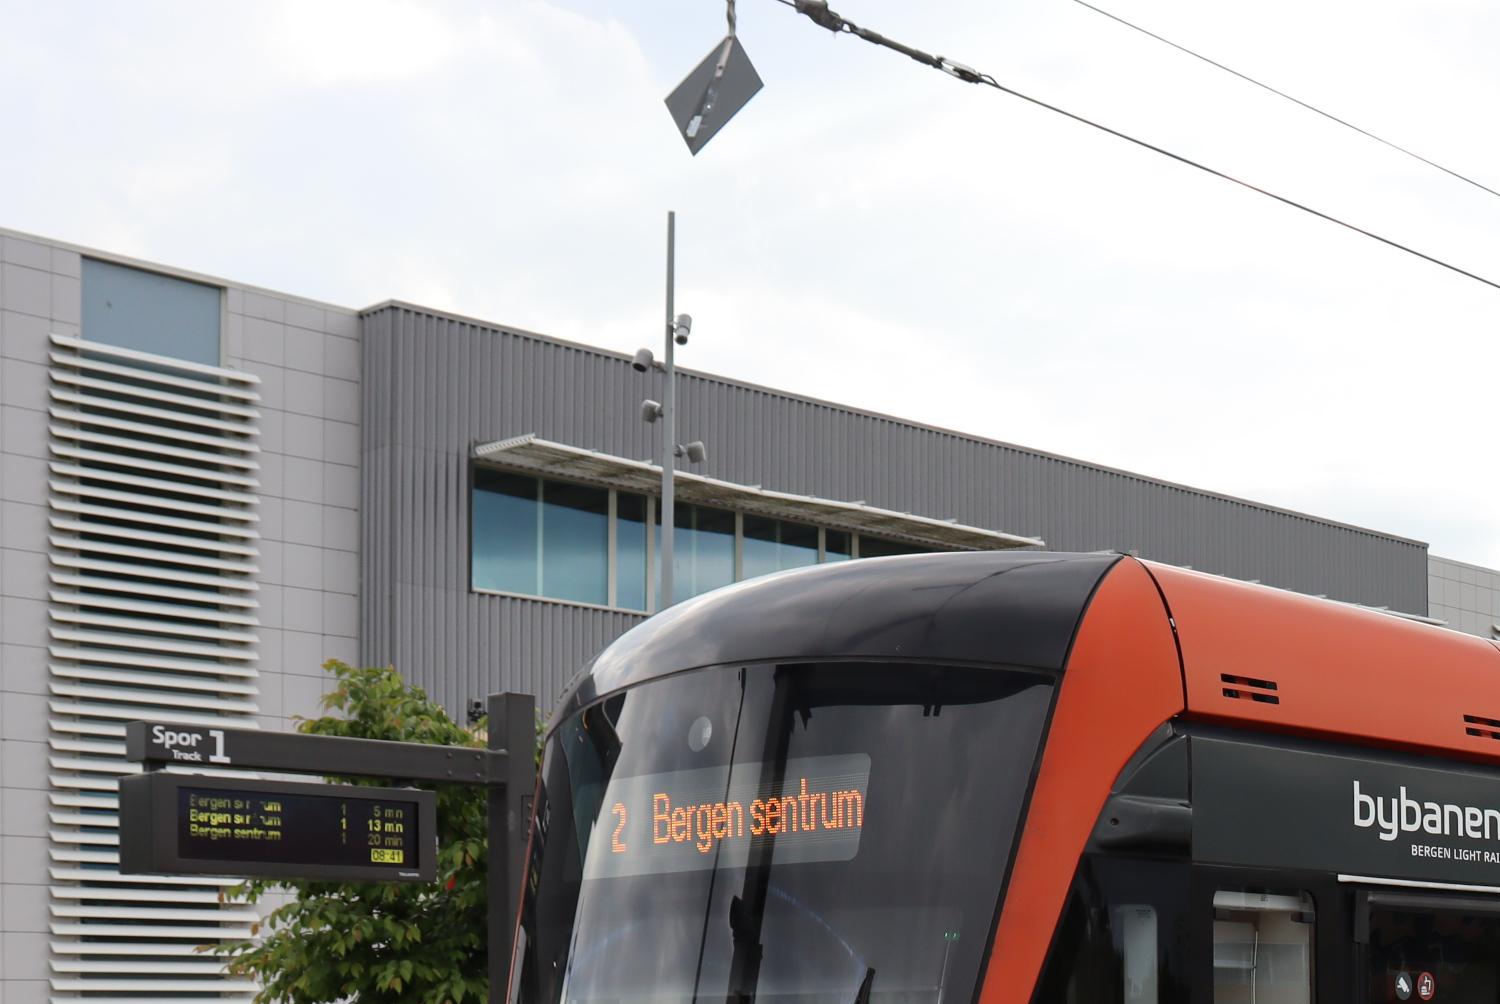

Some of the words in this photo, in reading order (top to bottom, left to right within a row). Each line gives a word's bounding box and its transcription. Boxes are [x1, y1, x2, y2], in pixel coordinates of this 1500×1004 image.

[152, 725, 202, 747] Spor
[208, 730, 231, 763] 1
[172, 749, 201, 761] Track
[189, 808, 232, 826] Bergen
[340, 817, 347, 830] 1
[368, 819, 381, 832] 13
[373, 805, 381, 818] 5
[384, 808, 404, 820] mn
[611, 803, 627, 853] 2
[653, 793, 744, 853] Bergen
[750, 777, 863, 836] sentrum
[189, 823, 231, 840] Bergen
[234, 827, 281, 840] sentrum
[368, 833, 381, 846] 20
[384, 835, 403, 847] min
[1411, 844, 1451, 860] BERGEN
[1453, 848, 1482, 862] LIGHT
